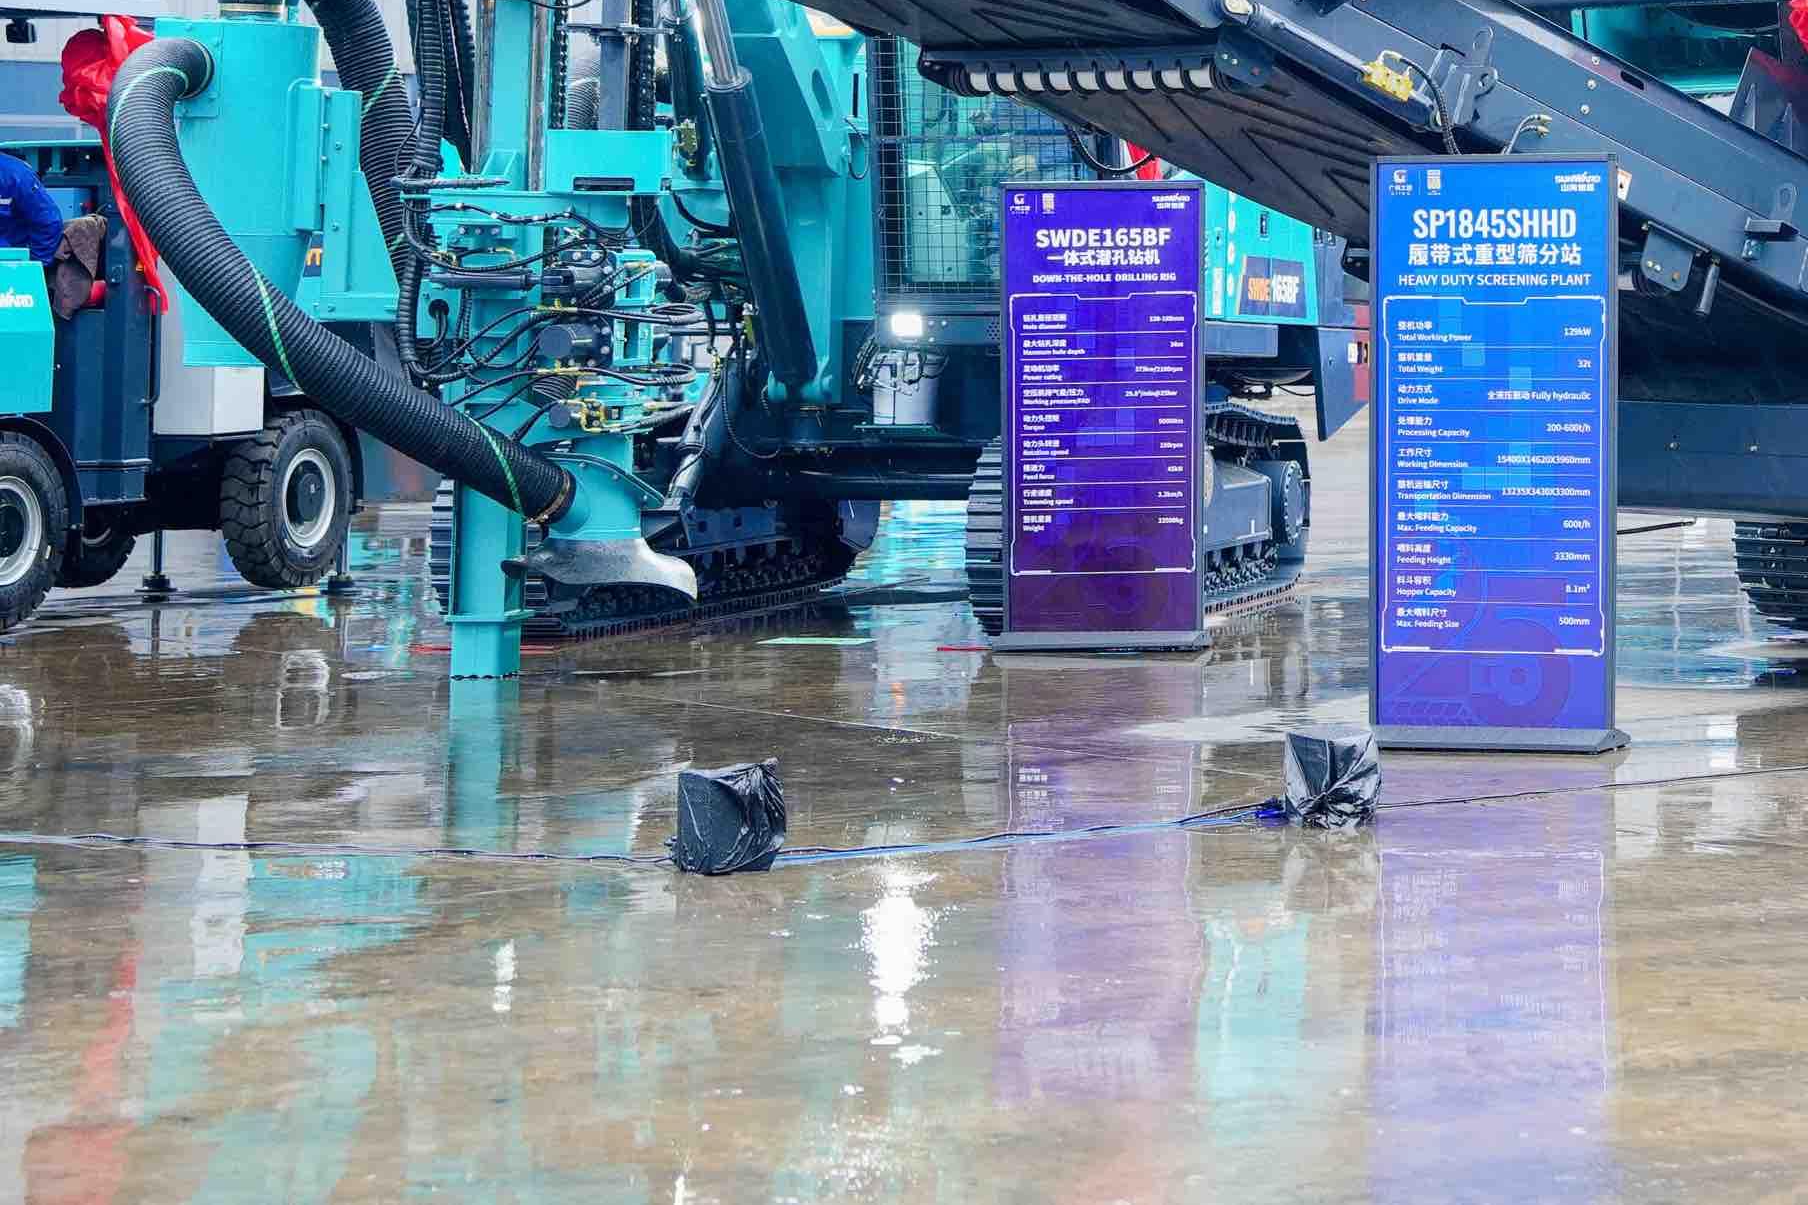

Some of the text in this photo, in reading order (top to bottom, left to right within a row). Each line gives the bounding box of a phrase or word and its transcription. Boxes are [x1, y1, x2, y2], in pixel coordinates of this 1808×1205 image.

[1412, 208, 1577, 239] SP1845SHHD
[1036, 227, 1171, 248] SWDE165BF
[1046, 249, 1161, 267] 一体式潜孔钻机
[1408, 243, 1582, 267] 履带式重型筛分站
[1032, 272, 1177, 284] DOWN-THE-HOLE DRILLING RIG
[1398, 274, 1592, 286] HEAVY DUTY SCREENING PLANT
[1398, 333, 1473, 343] Total Working Power
[1398, 365, 1444, 375] Total Weight
[1397, 396, 1440, 405] Drive Mode
[1531, 391, 1552, 403] Fully
[1552, 391, 1592, 403] hydraulic
[1397, 428, 1471, 438] Processing Capacity
[1397, 460, 1469, 470] Working Dimension
[1397, 492, 1492, 502] Transportation Dimension
[1397, 524, 1478, 534] Max. Feeding Capacity
[1396, 555, 1452, 565] Feeding Height
[1396, 587, 1458, 598] Hopper Capacity
[1396, 620, 1460, 630] Max. Feeding Size
